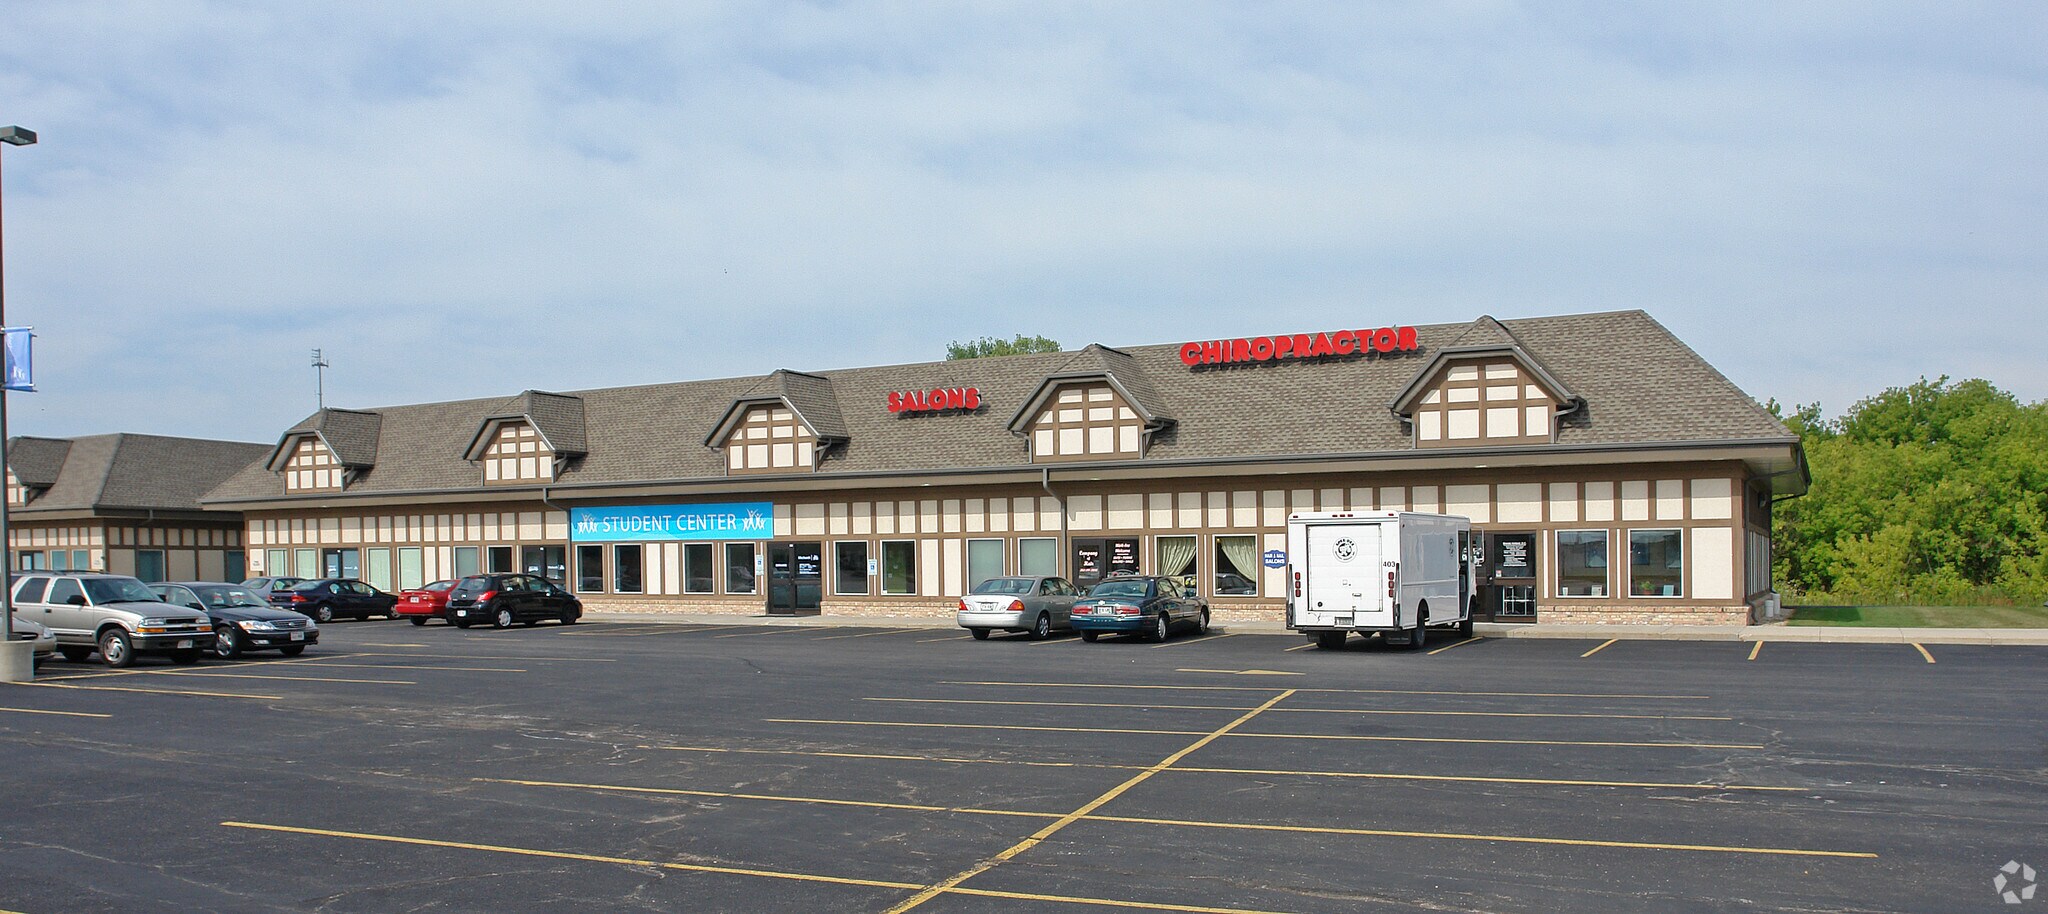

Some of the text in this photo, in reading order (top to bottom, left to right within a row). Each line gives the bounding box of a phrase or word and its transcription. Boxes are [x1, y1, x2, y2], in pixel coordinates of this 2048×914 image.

[1179, 326, 1419, 366] CHIROPRACTOR
[887, 386, 981, 413] SALONS
[602, 513, 737, 533] STUDENT CENTER
